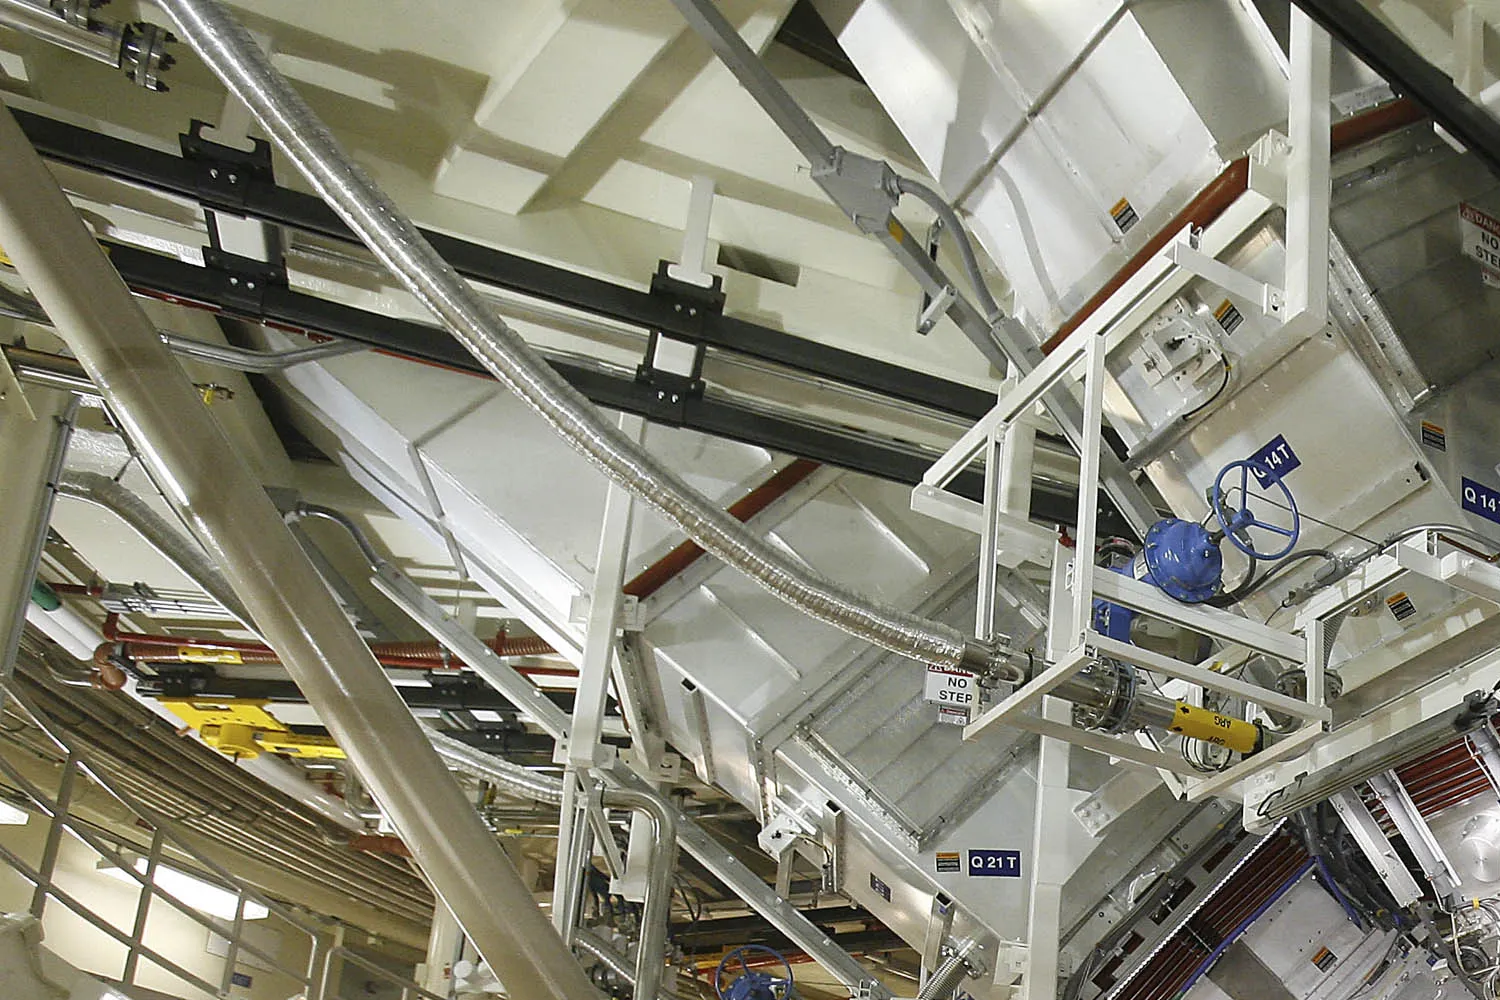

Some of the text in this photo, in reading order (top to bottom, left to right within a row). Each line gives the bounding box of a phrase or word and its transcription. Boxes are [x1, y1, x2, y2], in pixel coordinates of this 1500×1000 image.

[1481, 232, 1499, 250] NO
[1464, 486, 1477, 504] Q
[948, 677, 968, 688] NO
[939, 690, 973, 703] STEP
[971, 856, 983, 869] Q
[987, 856, 1003, 869] 21
[1006, 856, 1017, 869] T
